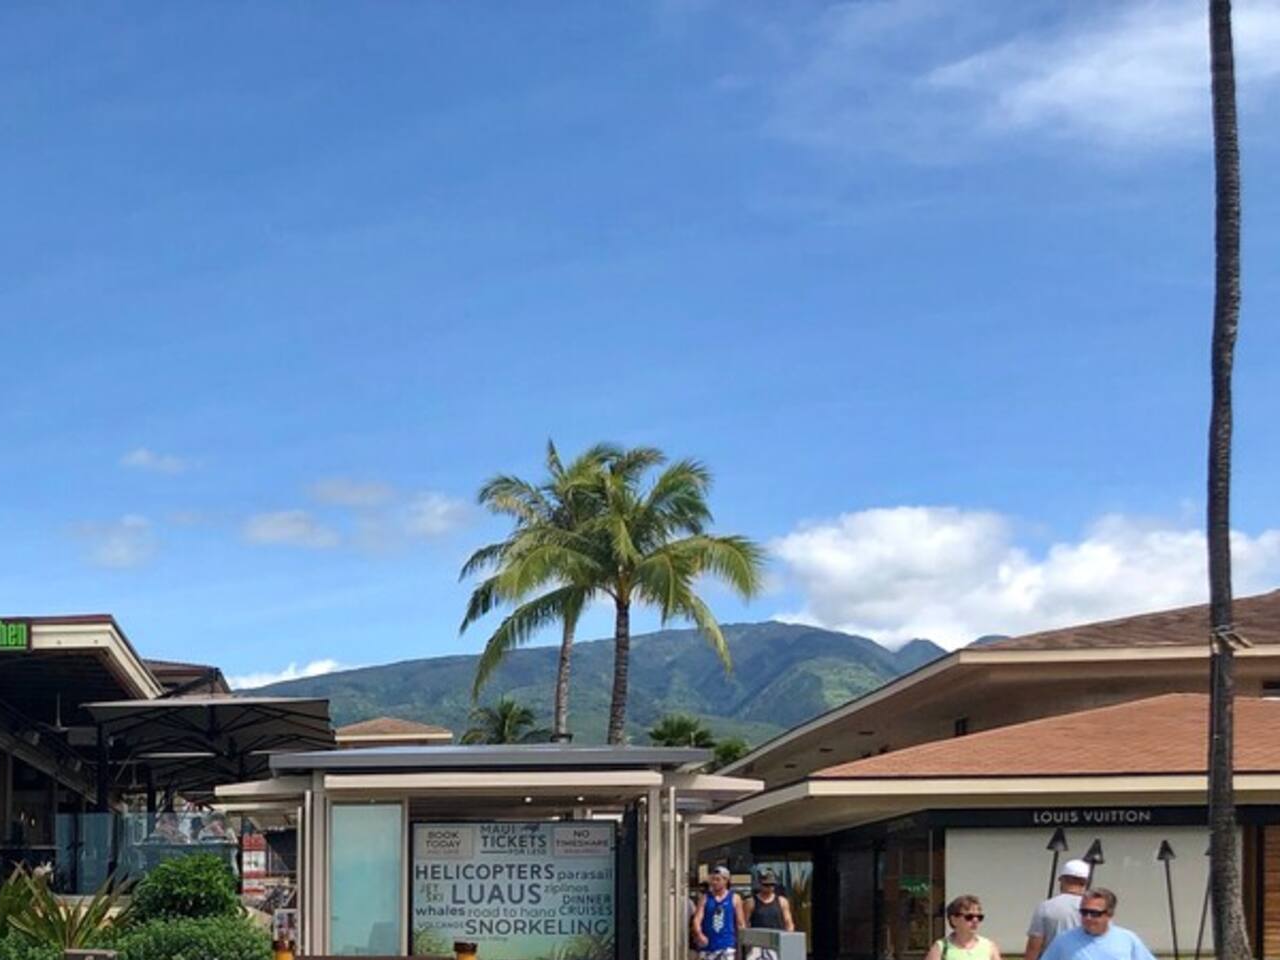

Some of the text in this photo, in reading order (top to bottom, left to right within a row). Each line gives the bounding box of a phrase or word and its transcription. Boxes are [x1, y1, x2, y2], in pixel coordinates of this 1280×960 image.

[1033, 810, 1151, 823] LOUIS VUITTON
[428, 831, 459, 839] BOOK
[480, 825, 516, 834] MAUI
[573, 830, 590, 838] NO
[425, 840, 462, 848] TODAY
[481, 835, 547, 848] TICKETS
[415, 863, 555, 880] HELICOPTERS
[557, 869, 612, 882] parasail
[451, 883, 542, 905] LUAUS
[563, 894, 611, 905] DINNER
[415, 905, 465, 916] whales
[467, 906, 500, 918] road
[503, 907, 517, 918] to
[558, 905, 612, 916] CRUISES
[465, 919, 609, 935] SNORKELING
